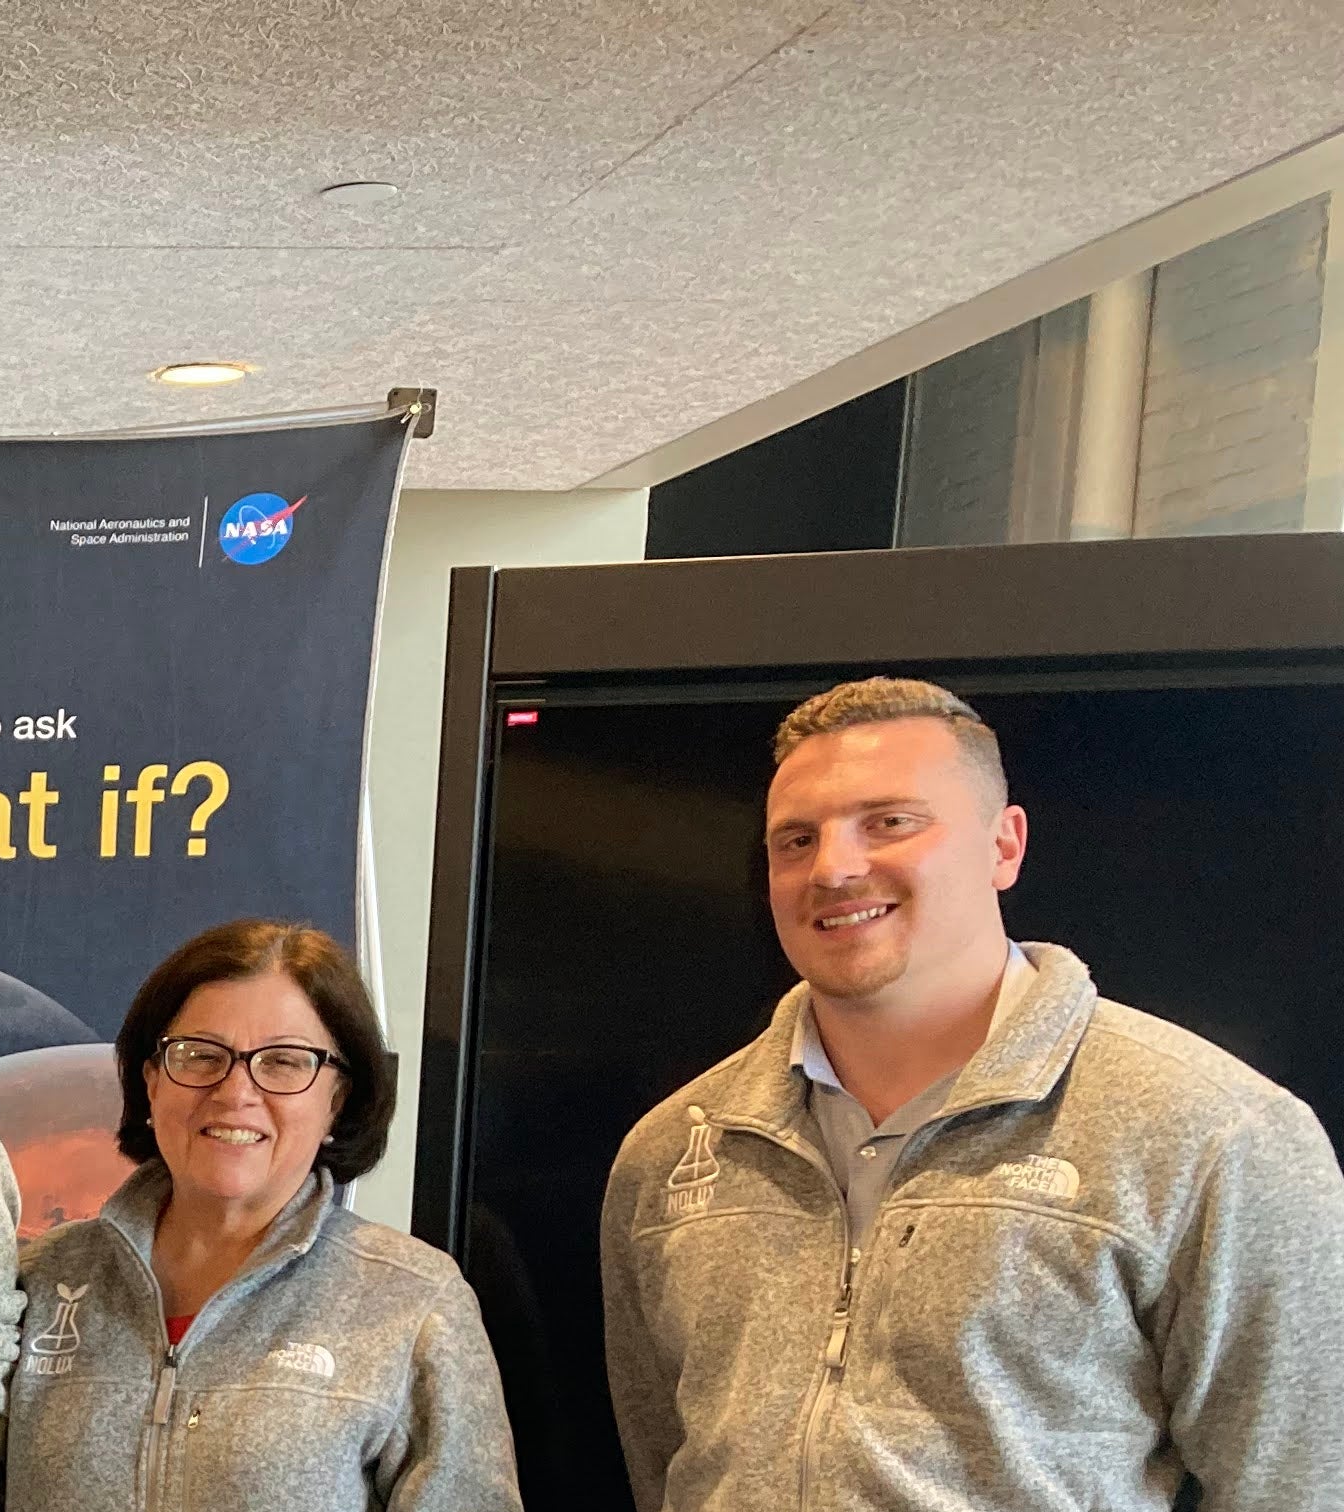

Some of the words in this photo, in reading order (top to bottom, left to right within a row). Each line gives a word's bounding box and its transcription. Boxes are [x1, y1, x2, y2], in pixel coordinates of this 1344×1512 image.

[50, 519, 97, 532] National
[99, 517, 166, 530] Aeronautics
[168, 516, 191, 528] and
[223, 518, 289, 544] NASA
[70, 534, 107, 547] Space
[109, 531, 189, 544] Administration
[13, 708, 78, 740] ask
[99, 760, 231, 858] if?
[998, 1162, 1056, 1180] NORTH
[1028, 1153, 1059, 1171] THE
[1009, 1176, 1050, 1193] FACE
